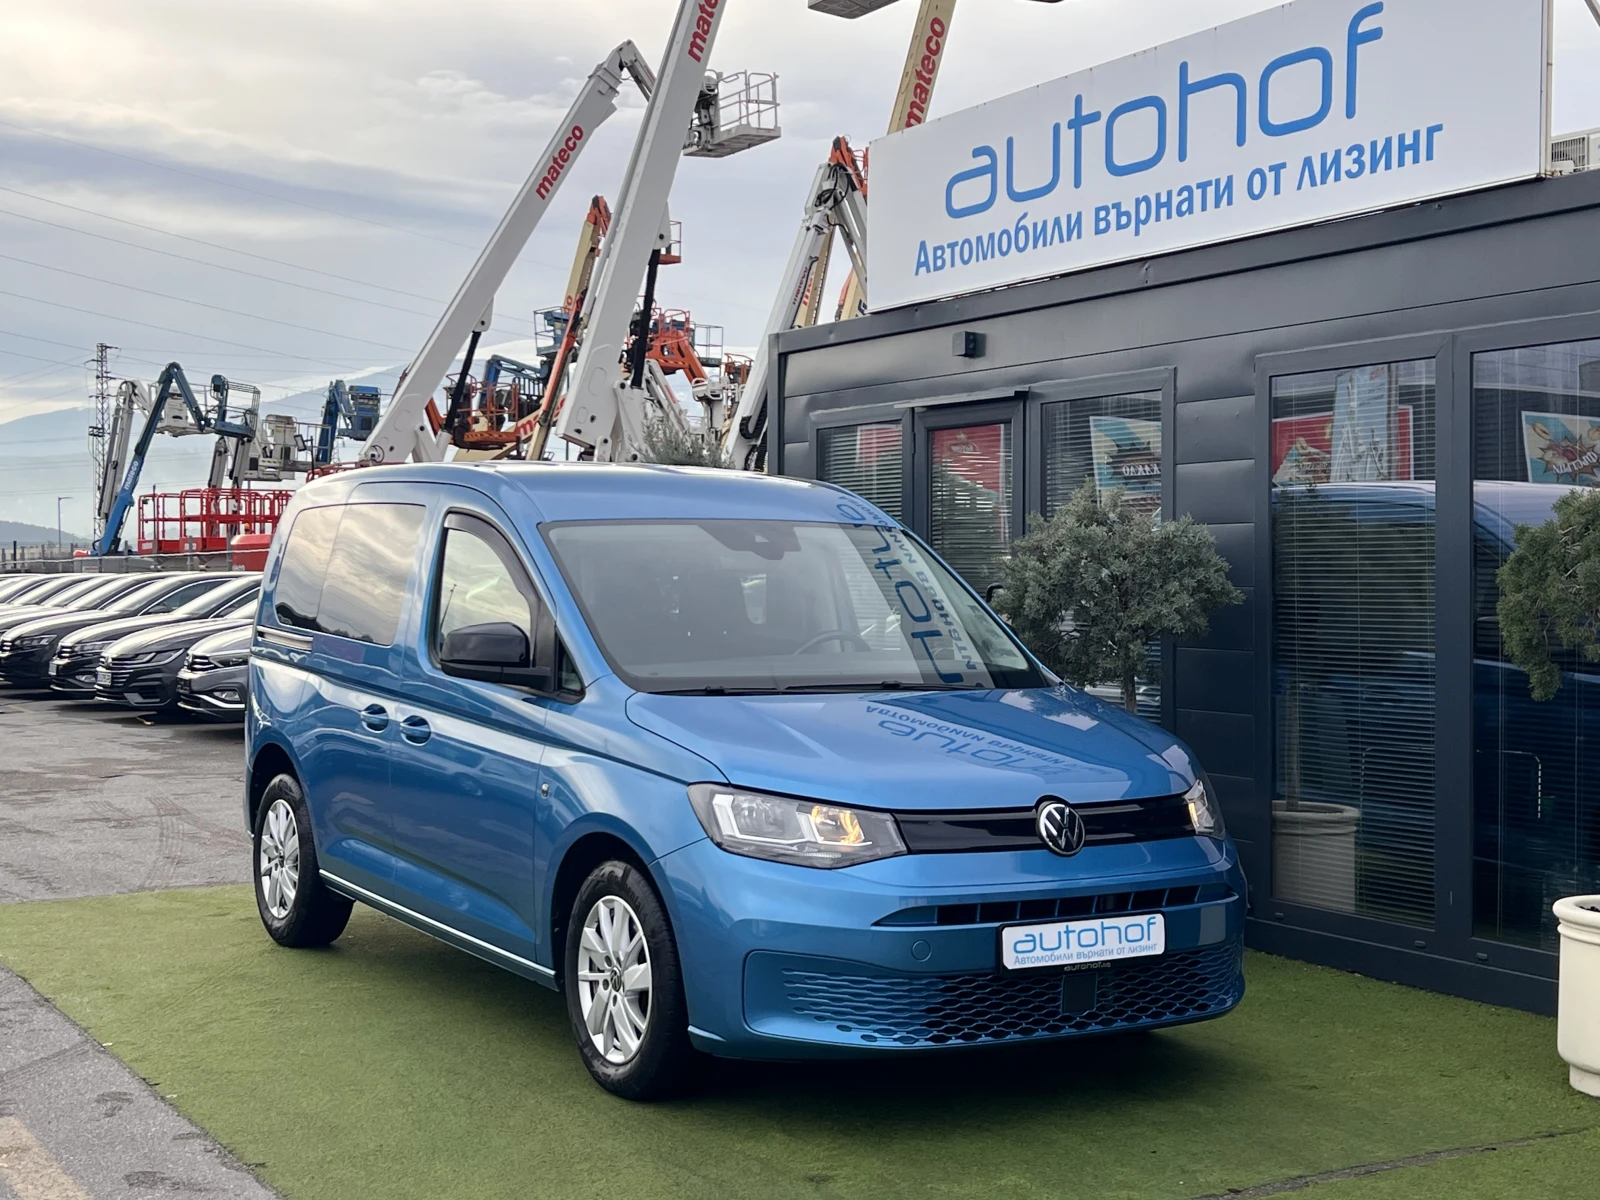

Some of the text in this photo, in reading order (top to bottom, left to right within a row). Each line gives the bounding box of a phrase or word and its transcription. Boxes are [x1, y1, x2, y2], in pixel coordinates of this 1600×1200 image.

[905, 16, 946, 128] mateco
[945, 1, 1384, 219] autohof
[535, 124, 584, 201] mateco
[915, 123, 1444, 276] Автомобили върнати от лизинг
[124, 460, 139, 490] mateco
[1013, 915, 1157, 954] autohof
[1014, 943, 1157, 965] Автомобили върнати от лизинг
